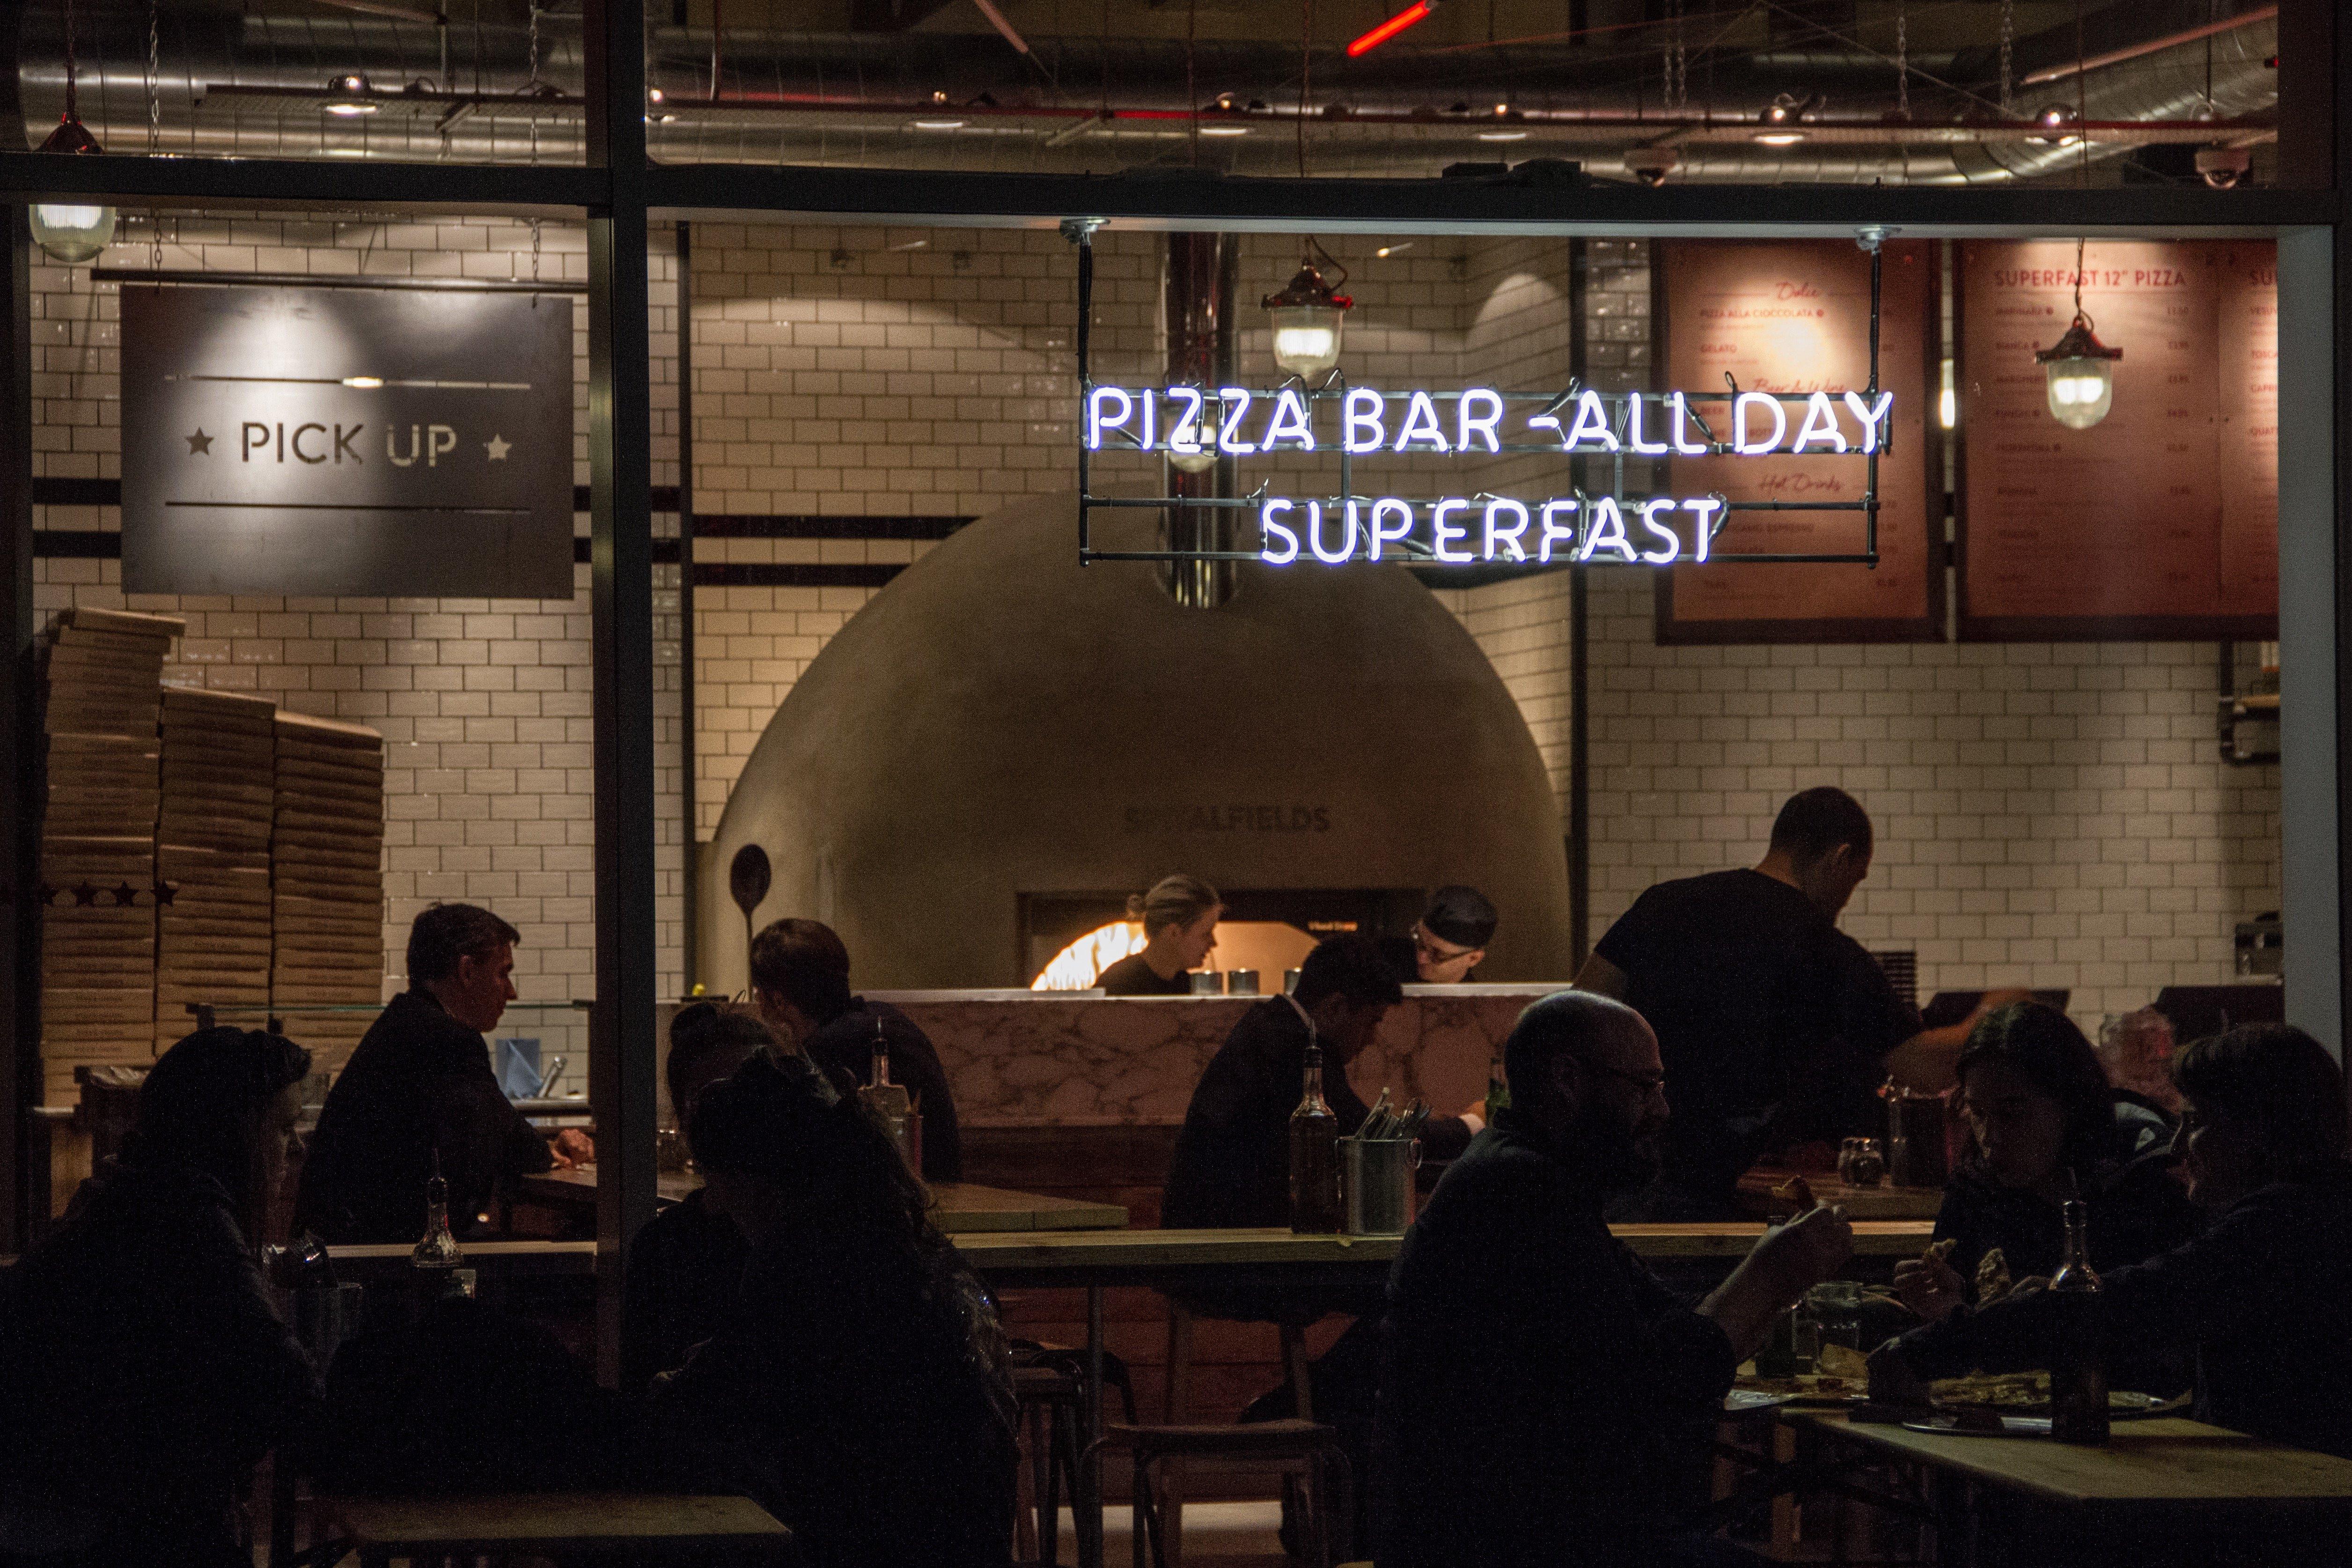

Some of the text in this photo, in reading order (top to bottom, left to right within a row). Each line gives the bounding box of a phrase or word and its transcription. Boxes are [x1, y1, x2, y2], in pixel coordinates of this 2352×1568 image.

[1995, 270, 2102, 286] SUPERFAST
[2135, 270, 2186, 286] PIZZA
[2248, 269, 2278, 286] SU
[1728, 309, 1750, 318] ALLA
[1753, 309, 1813, 318] CIOCCOLATA
[1699, 343, 1737, 353] GELATO
[1089, 386, 1315, 454] PIZZA
[1345, 386, 1503, 454] BAR
[1734, 390, 1894, 455] DAY
[242, 422, 457, 467] PICK UP
[1261, 496, 1721, 565] SUPERFAST
